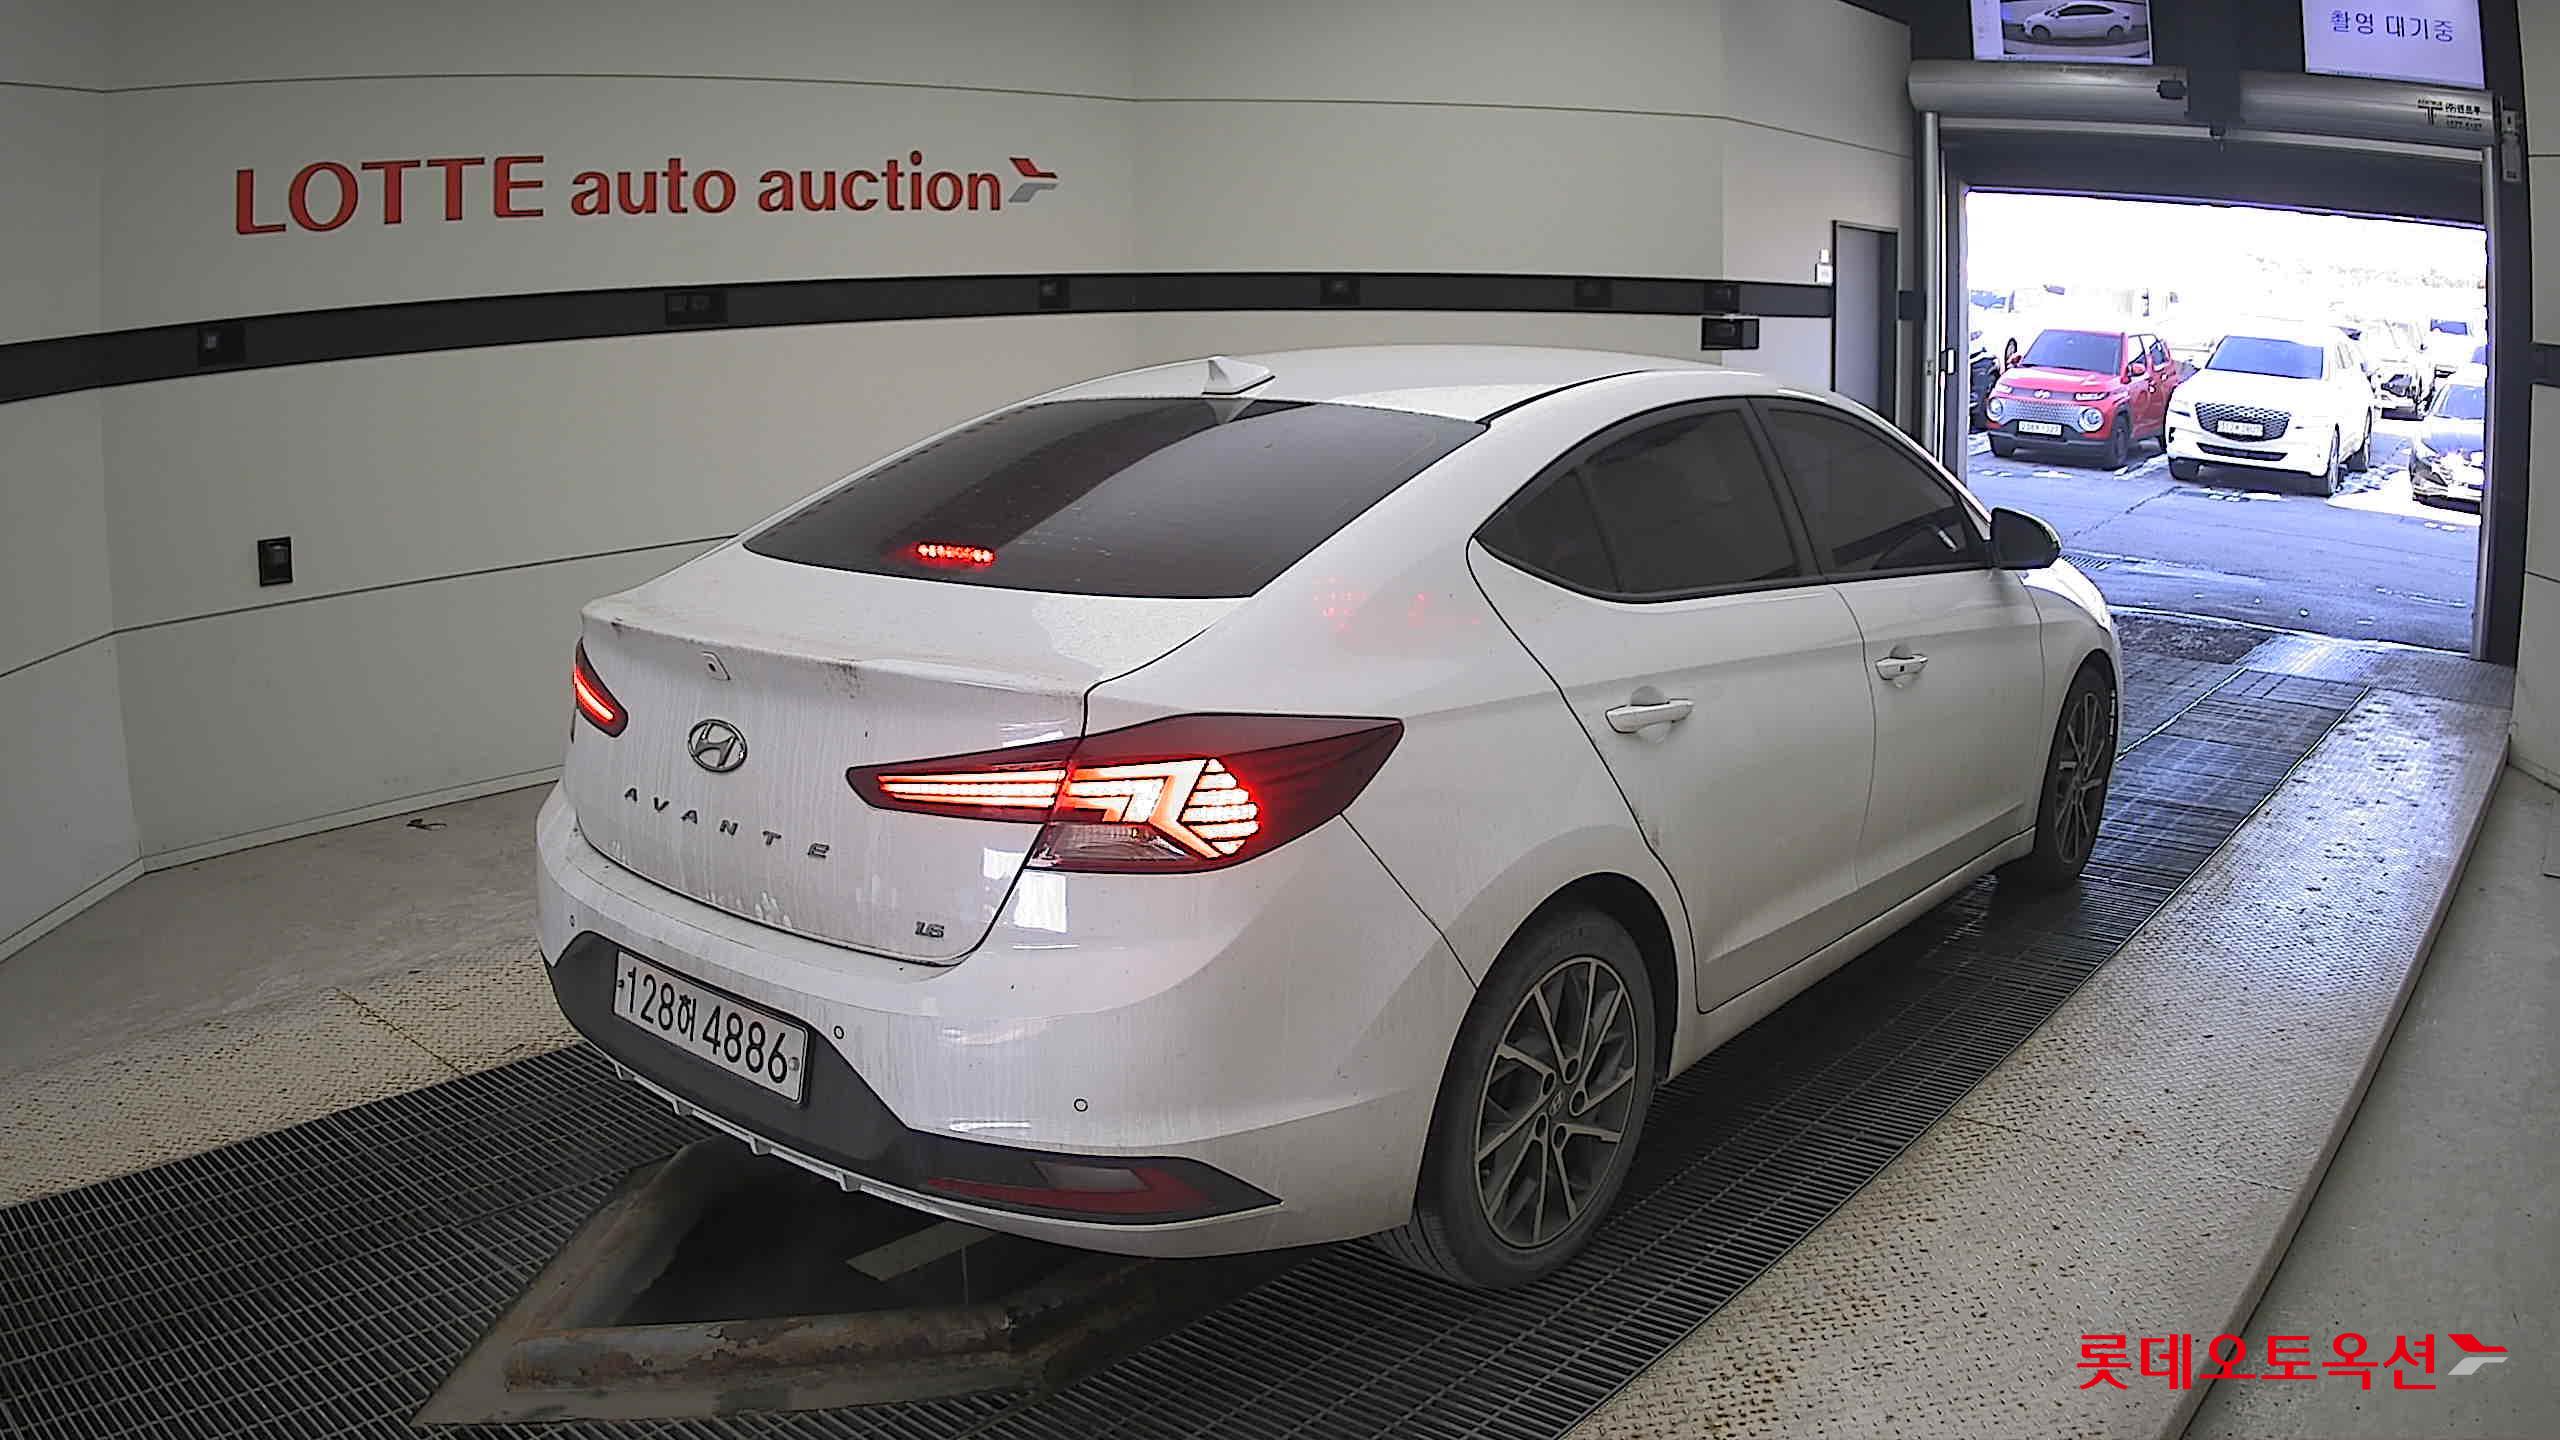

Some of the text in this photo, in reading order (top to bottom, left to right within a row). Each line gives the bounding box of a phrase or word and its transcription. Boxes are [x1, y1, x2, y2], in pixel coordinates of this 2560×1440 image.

[2331, 10, 2454, 43] 촬영 대기중
[235, 150, 1002, 236] LOTTE auto auction
[624, 787, 831, 860] AVANTE
[702, 1005, 788, 1084] 4886
